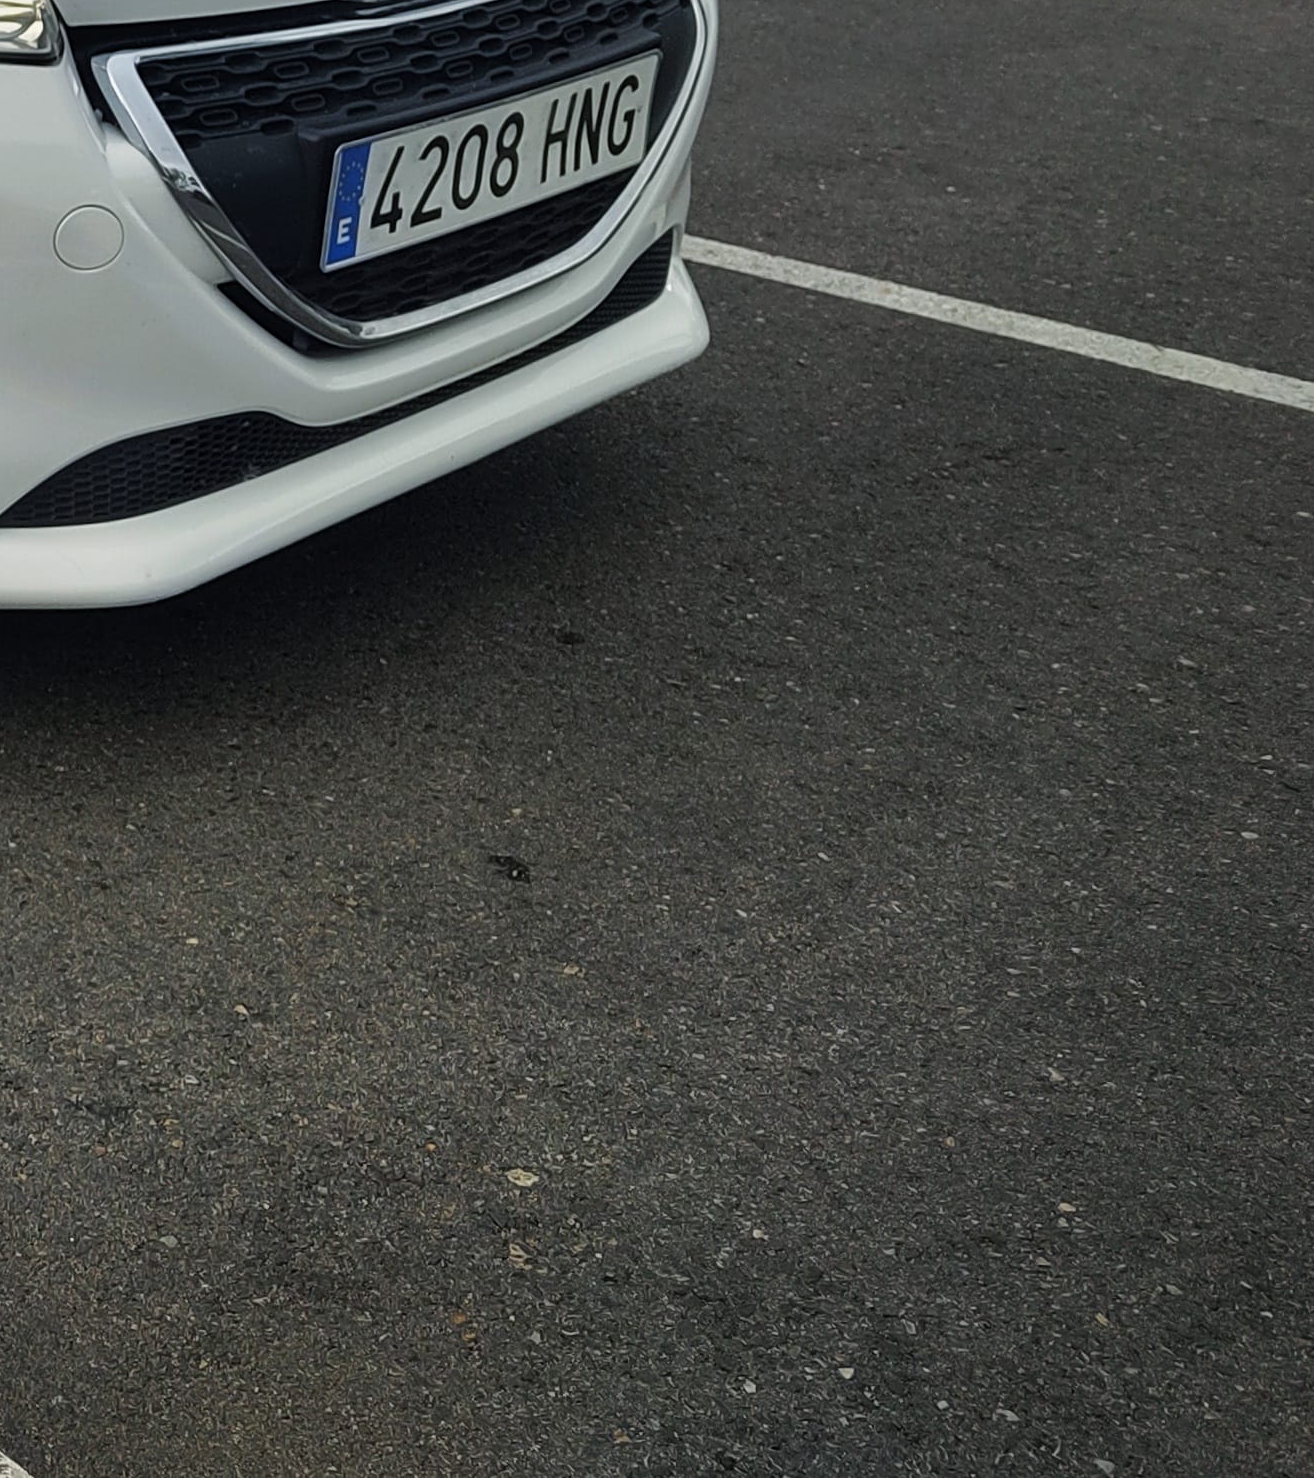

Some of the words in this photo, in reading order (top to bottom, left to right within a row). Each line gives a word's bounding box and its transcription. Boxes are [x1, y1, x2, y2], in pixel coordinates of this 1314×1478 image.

[336, 217, 353, 245] E
[370, 111, 525, 234] 4208
[539, 74, 640, 184] HNG
